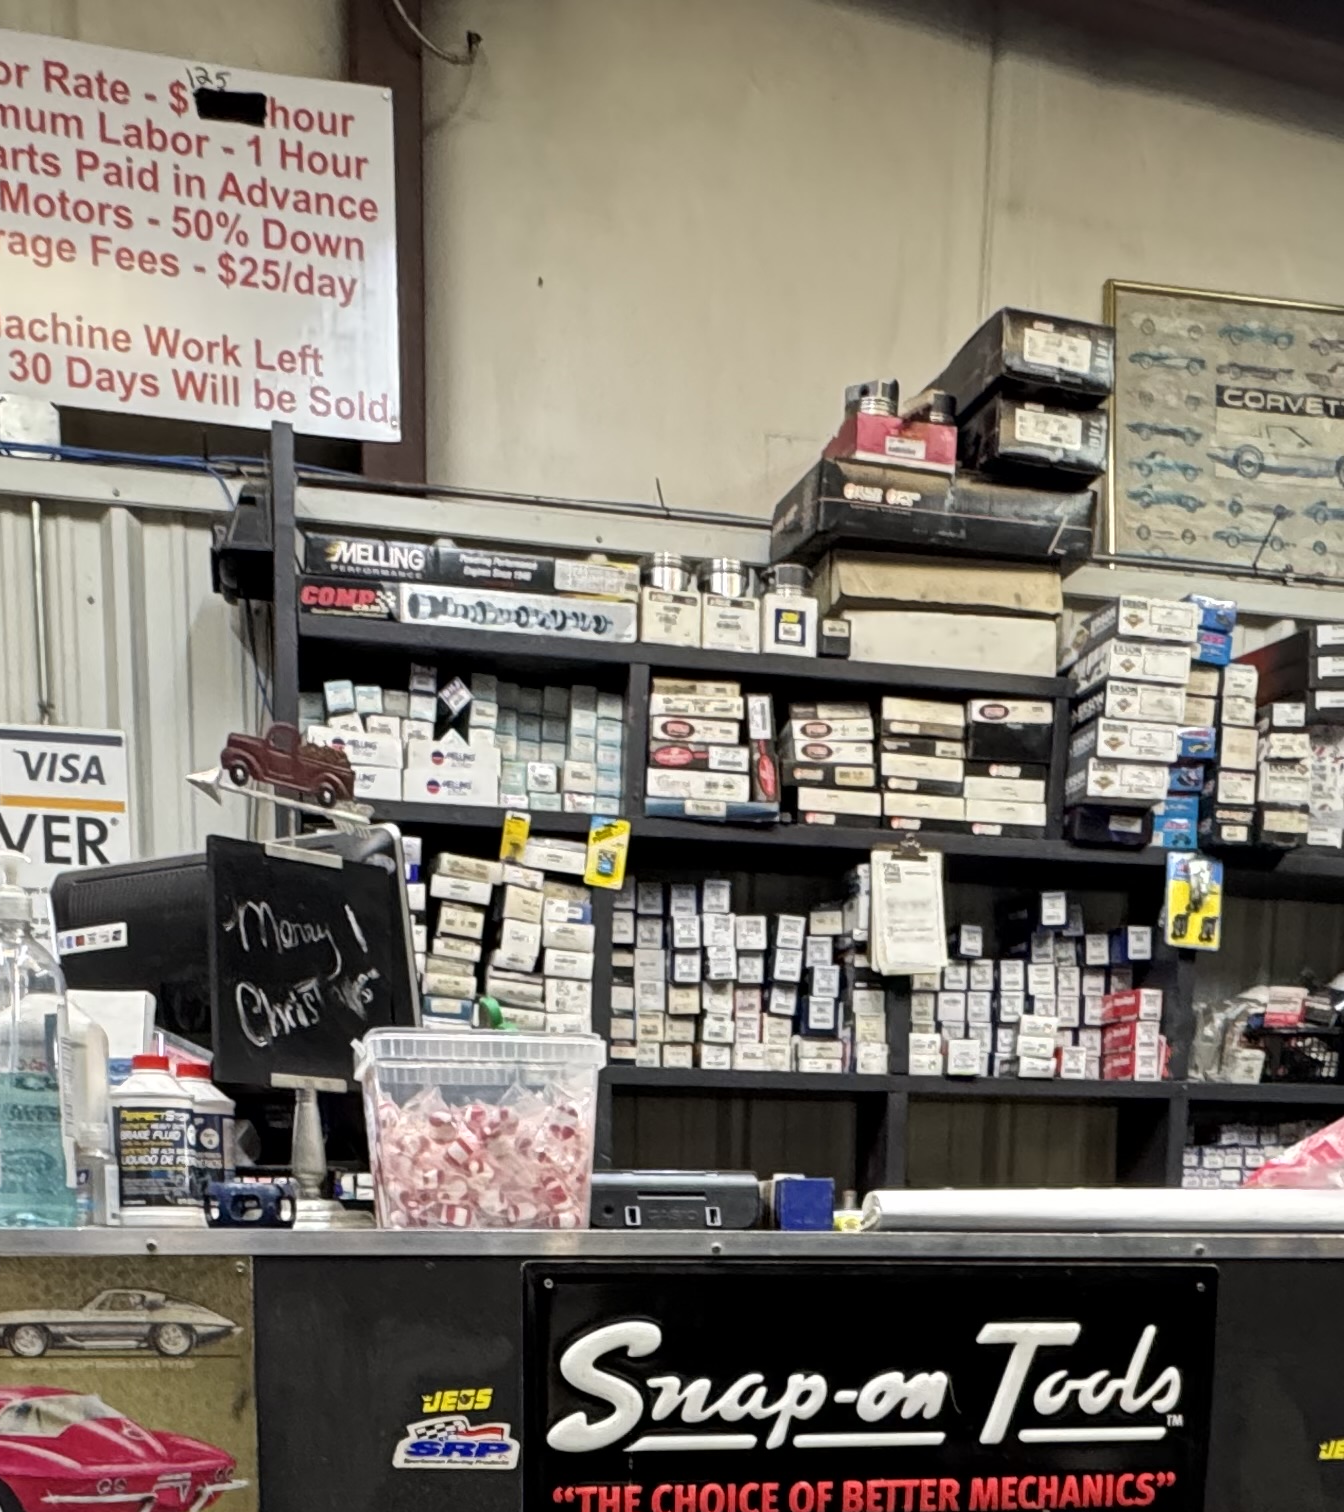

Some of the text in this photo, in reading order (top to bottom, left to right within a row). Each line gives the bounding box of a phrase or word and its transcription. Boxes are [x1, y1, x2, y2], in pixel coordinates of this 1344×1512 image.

[44, 59, 130, 104] Rate
[186, 67, 231, 90] 125
[100, 111, 210, 158] Labor
[247, 136, 262, 167] 1
[281, 140, 369, 180] Hour
[76, 143, 157, 192] Paid
[174, 160, 206, 199] in
[218, 173, 379, 222] Advance
[0, 182, 134, 229] Motors
[173, 207, 248, 248] 50%
[263, 218, 365, 262] Down
[91, 237, 179, 277] Fees
[218, 253, 357, 307] $25/day
[144, 326, 241, 368] Work
[256, 340, 323, 377] Left
[9, 351, 52, 385] 30
[68, 356, 159, 401] Days
[172, 370, 240, 407] Will
[255, 379, 297, 412] be
[309, 386, 389, 423] Sold
[335, 541, 425, 570] MELLING
[301, 586, 376, 606] COMP
[13, 749, 106, 785] VISA
[422, 1388, 494, 1413] JEGS
[546, 1320, 952, 1454] Snap-on
[974, 1321, 1182, 1446] Tools
[406, 1441, 512, 1458] SRP
